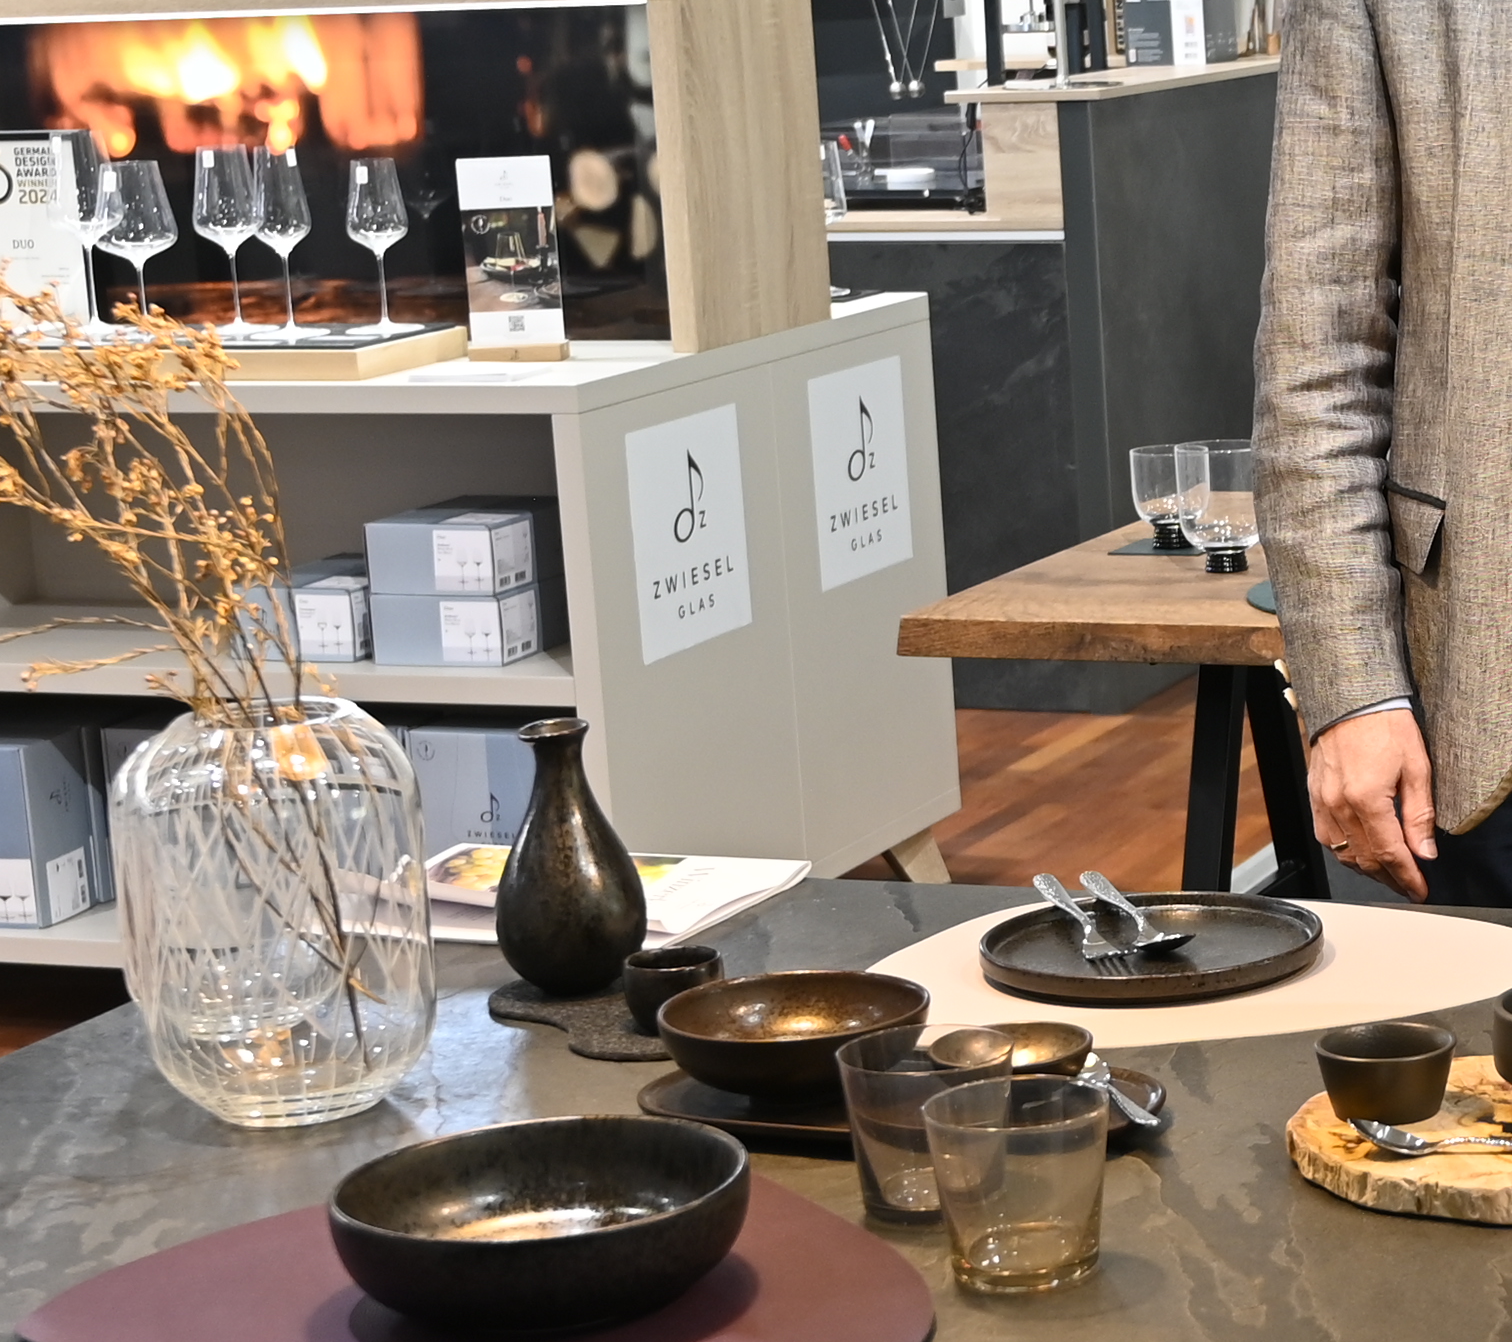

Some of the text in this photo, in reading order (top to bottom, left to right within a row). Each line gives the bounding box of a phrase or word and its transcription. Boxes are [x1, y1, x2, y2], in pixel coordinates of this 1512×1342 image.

[13, 147, 54, 156] GERMA
[12, 239, 35, 249] DUO
[829, 494, 899, 533] ZWIESEL
[850, 528, 883, 552] GLAS
[652, 555, 734, 600] ZWIESEL
[677, 593, 716, 620] GLAS
